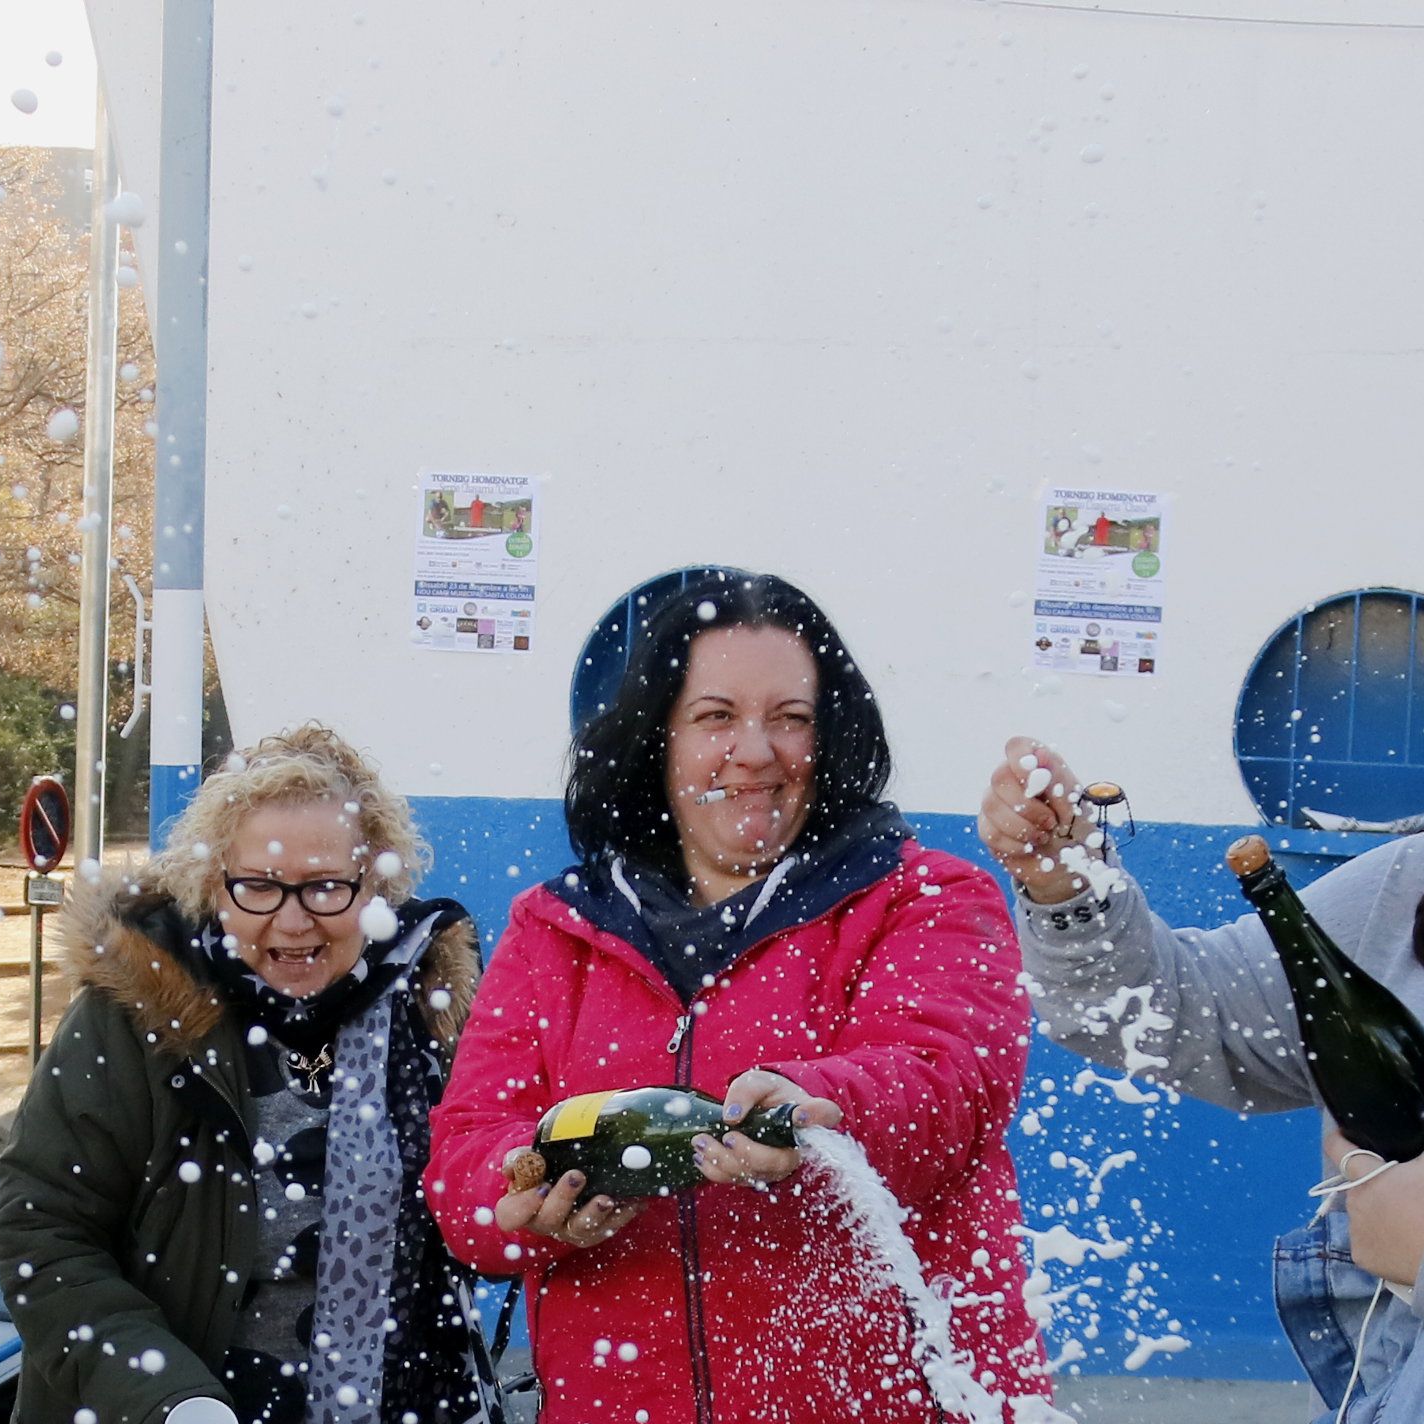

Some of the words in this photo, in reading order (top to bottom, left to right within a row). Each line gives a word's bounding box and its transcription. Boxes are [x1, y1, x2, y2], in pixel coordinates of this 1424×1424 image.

[431, 474, 470, 484] TORNEIG
[471, 475, 529, 485] HOMENATGE
[1054, 490, 1095, 501] TORNEIG
[1097, 492, 1157, 503] HOMENATGE
